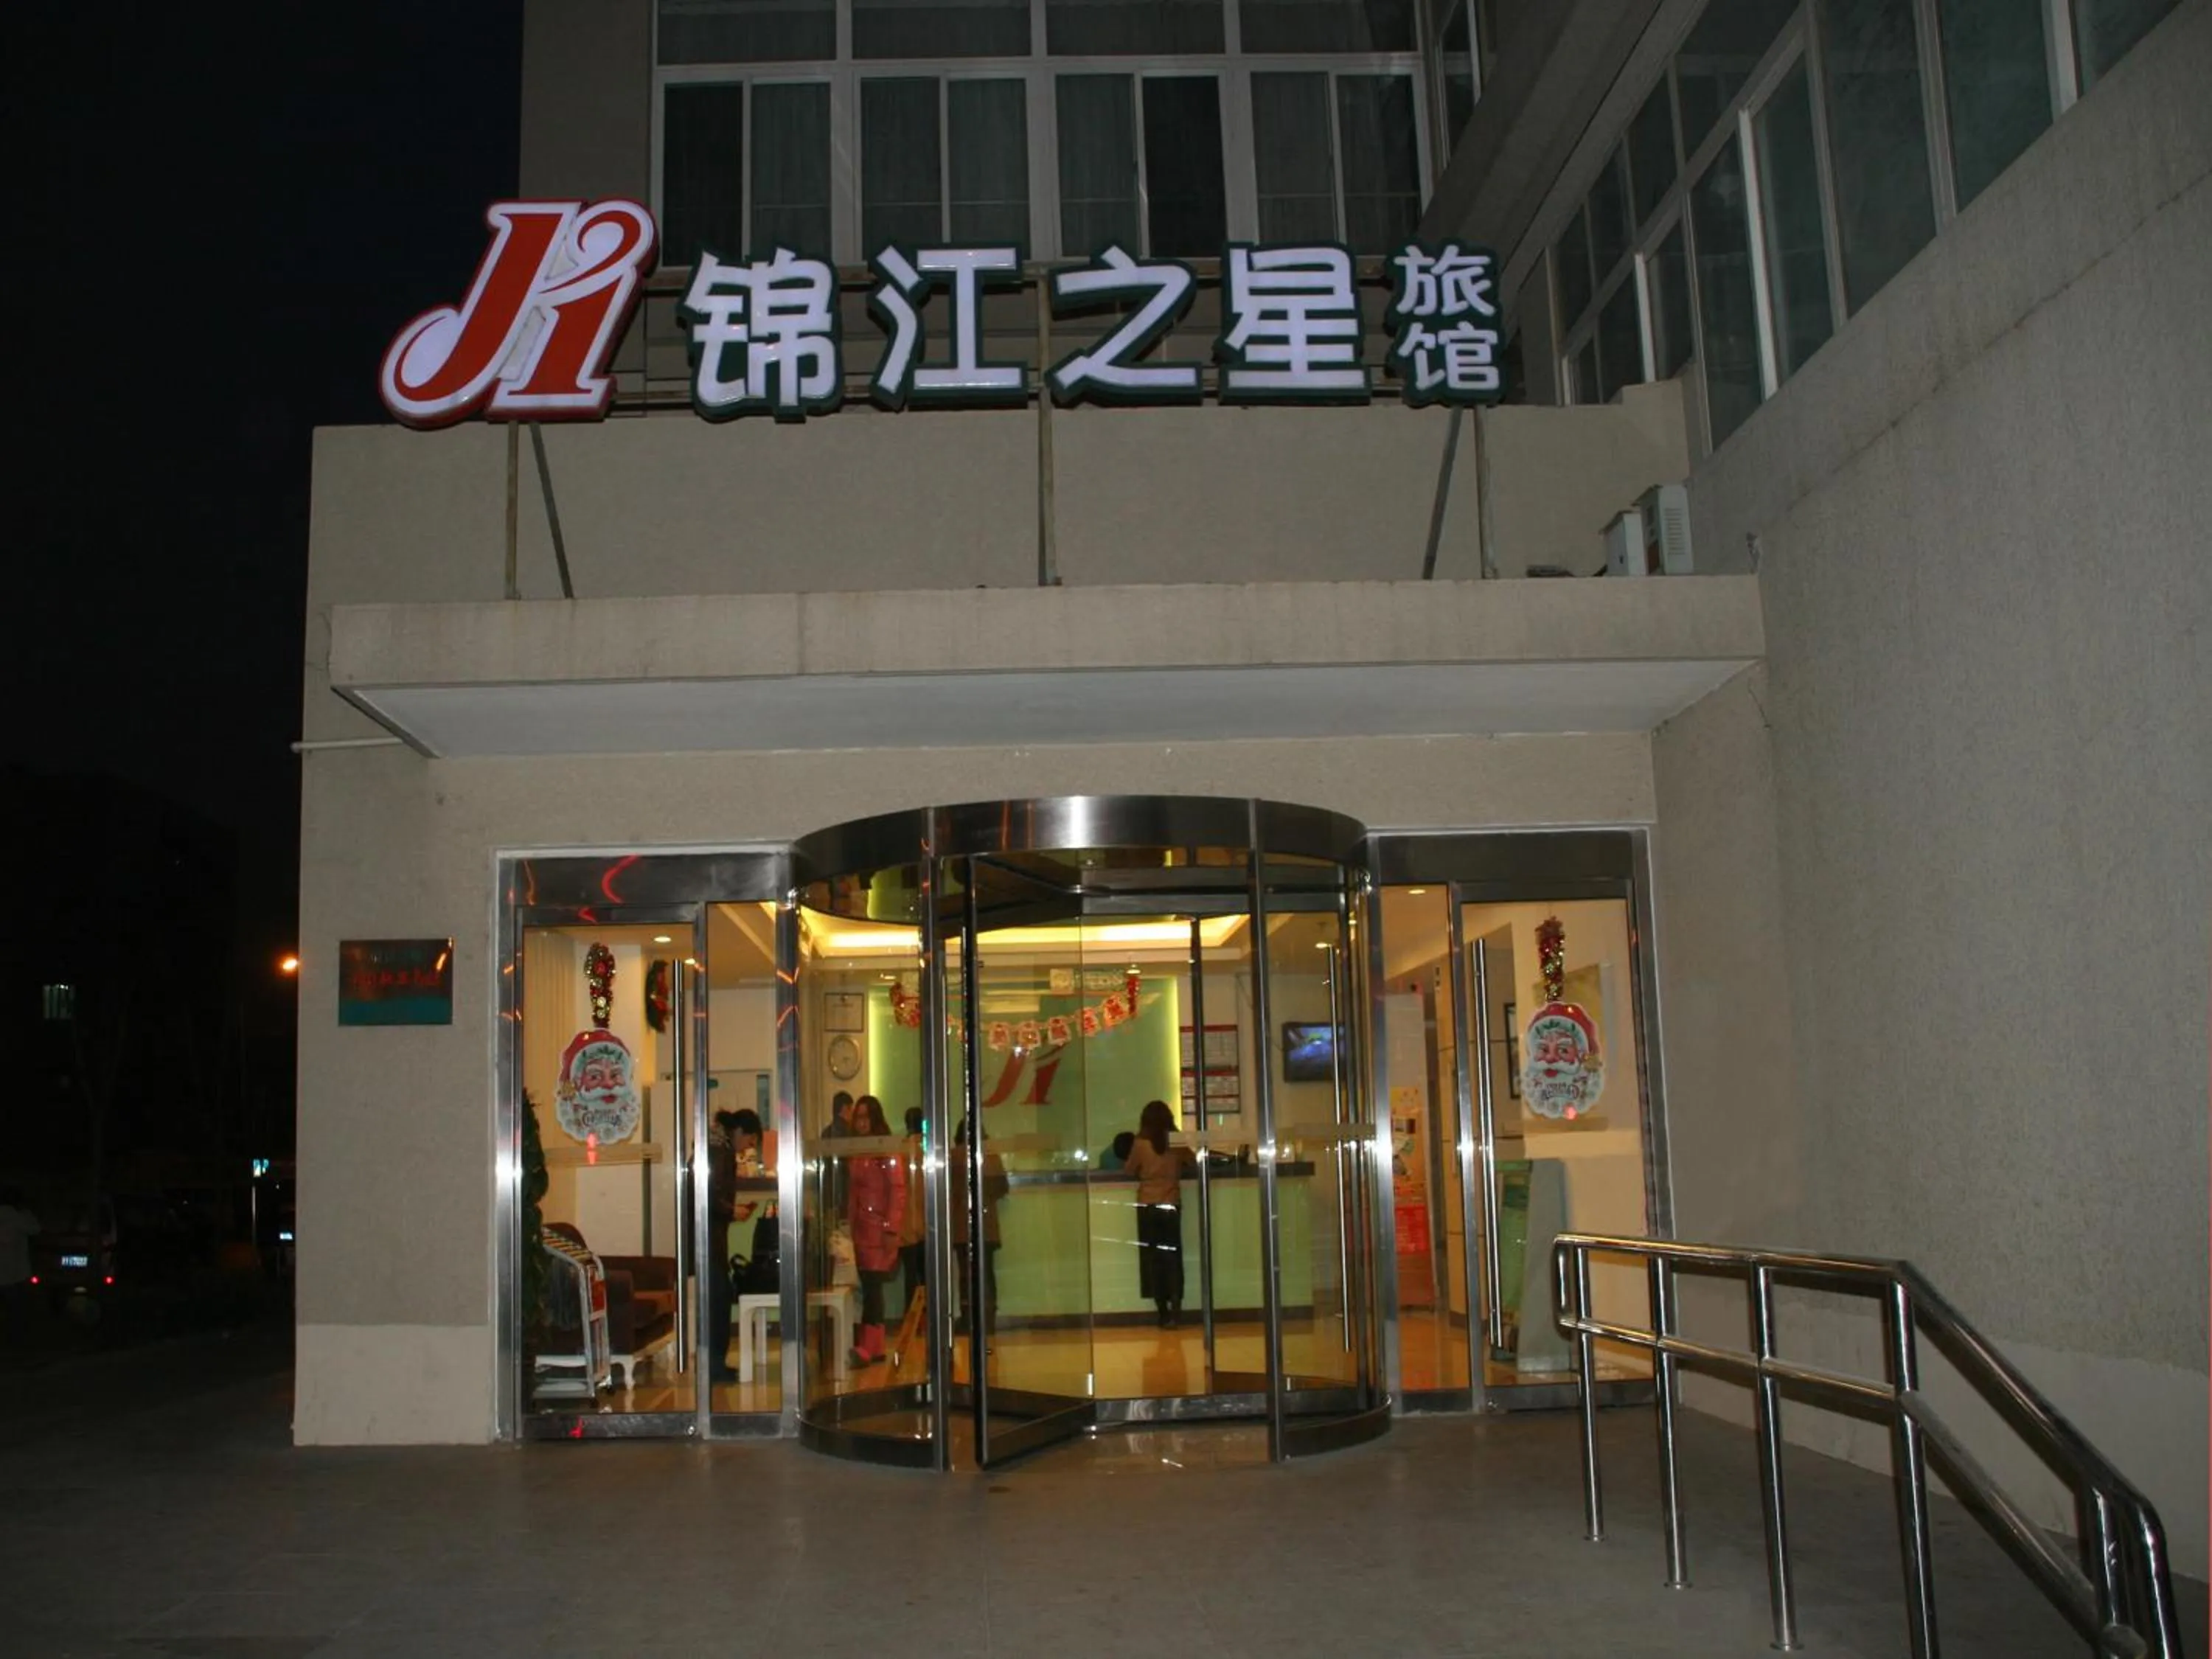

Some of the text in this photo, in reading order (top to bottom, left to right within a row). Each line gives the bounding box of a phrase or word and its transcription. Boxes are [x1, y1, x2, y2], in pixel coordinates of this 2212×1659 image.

[683, 245, 1366, 408] 锦江之星
[1393, 245, 1501, 392] 旅馆
